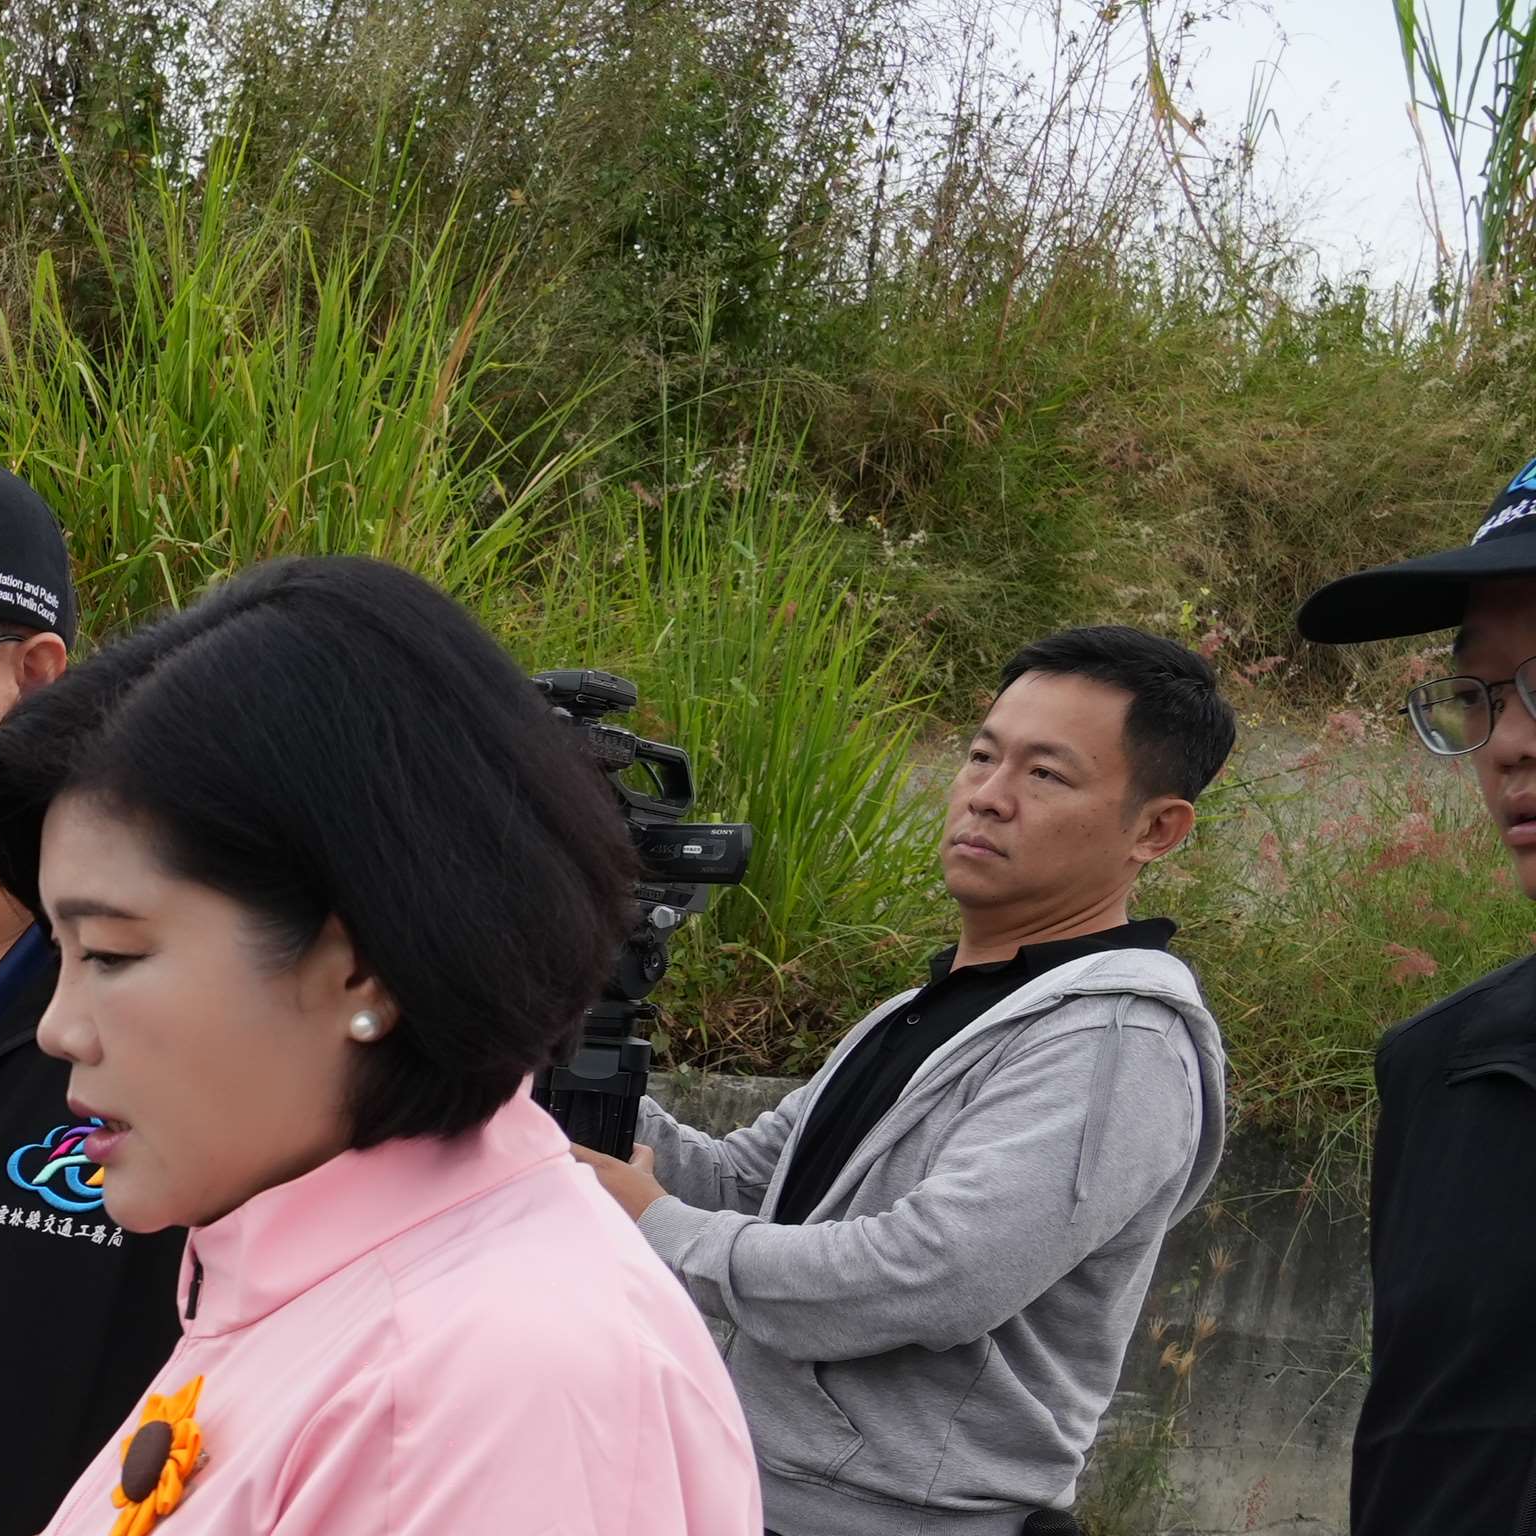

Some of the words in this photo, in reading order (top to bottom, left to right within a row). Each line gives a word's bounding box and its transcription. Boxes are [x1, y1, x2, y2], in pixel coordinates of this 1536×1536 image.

[15, 592, 37, 612] Yunlin
[37, 603, 57, 626] County
[24, 582, 40, 597] and
[39, 587, 59, 609] Public
